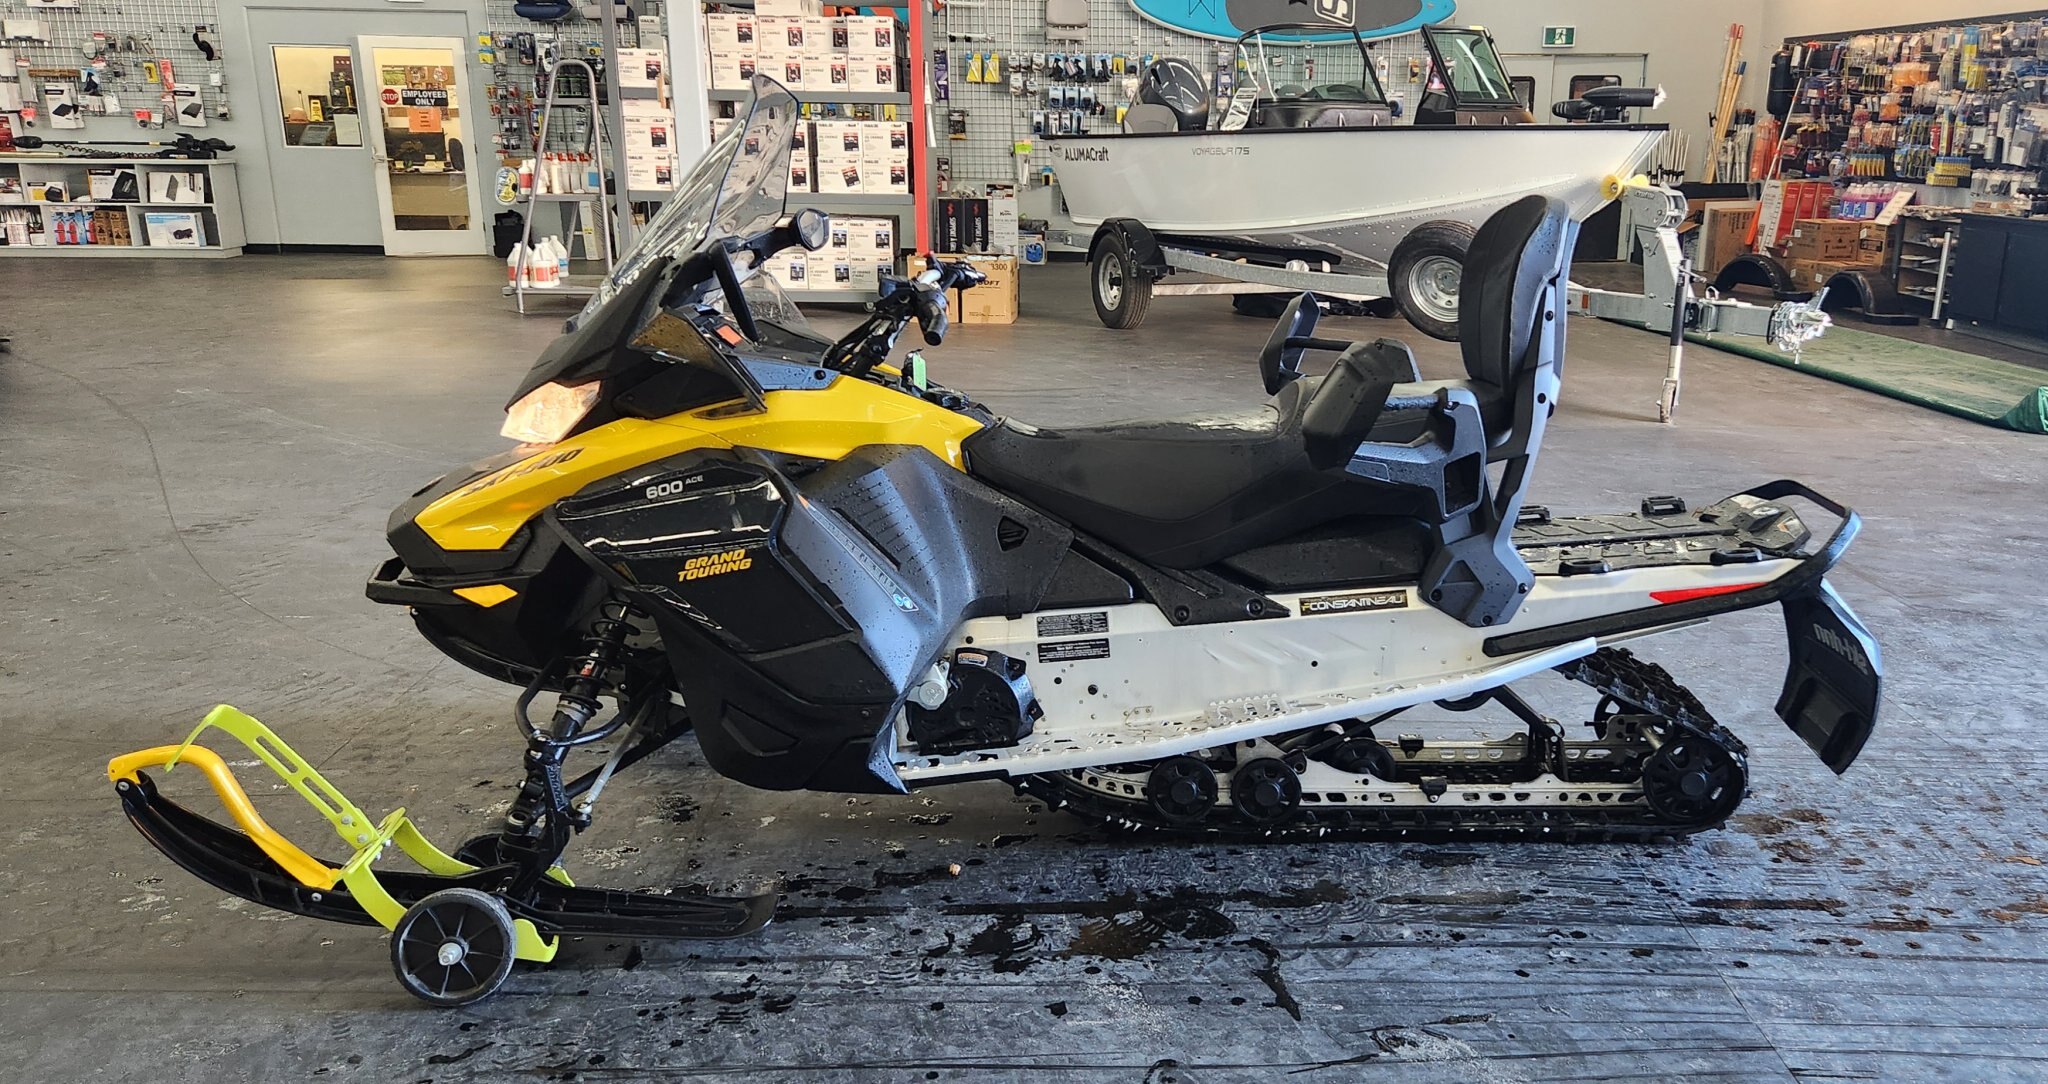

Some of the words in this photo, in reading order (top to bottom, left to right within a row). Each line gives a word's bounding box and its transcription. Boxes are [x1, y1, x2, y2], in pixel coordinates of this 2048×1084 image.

[402, 90, 447, 98] EMPLOYEES
[1064, 146, 1109, 162] ALUMACraft
[645, 480, 684, 500] 600
[685, 474, 704, 485] ACE
[677, 557, 753, 583] TOURING
[684, 548, 746, 570] GRAND
